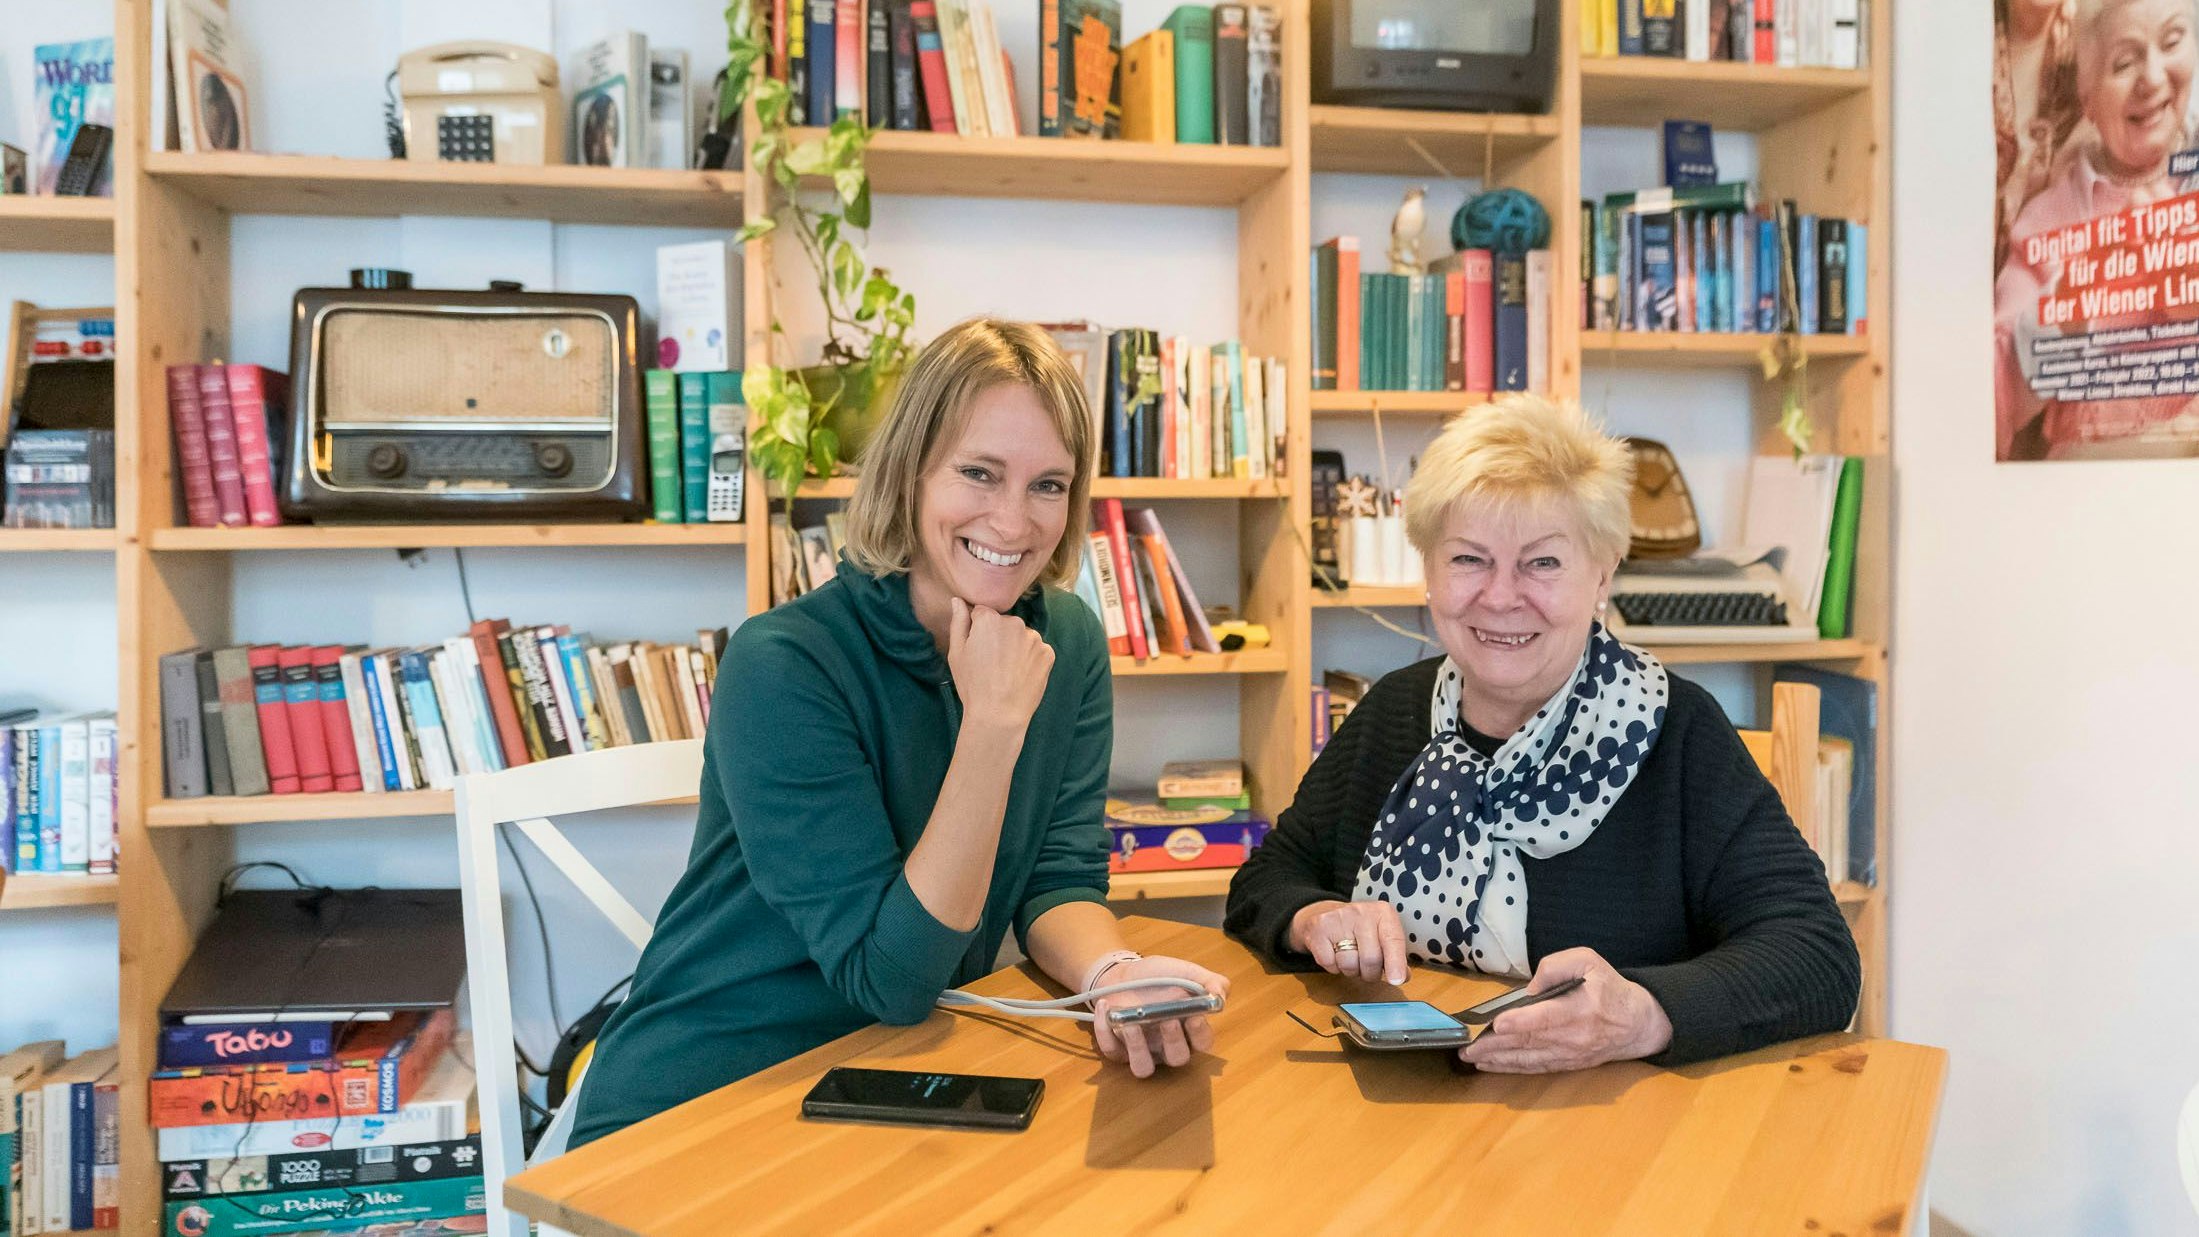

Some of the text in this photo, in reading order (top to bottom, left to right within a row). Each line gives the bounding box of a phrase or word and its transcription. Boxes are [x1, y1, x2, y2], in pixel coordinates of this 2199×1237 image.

[2027, 199, 2198, 267] Digital fit: Tipps
[2068, 255, 2099, 288] für
[2104, 248, 2138, 281] die
[2043, 273, 2199, 325] der Wiener Lin
[205, 1027, 293, 1058] Tabu
[381, 1062, 395, 1111] KOSMOS
[280, 1170, 321, 1184] PUZZLE
[281, 1159, 321, 1174] 1000
